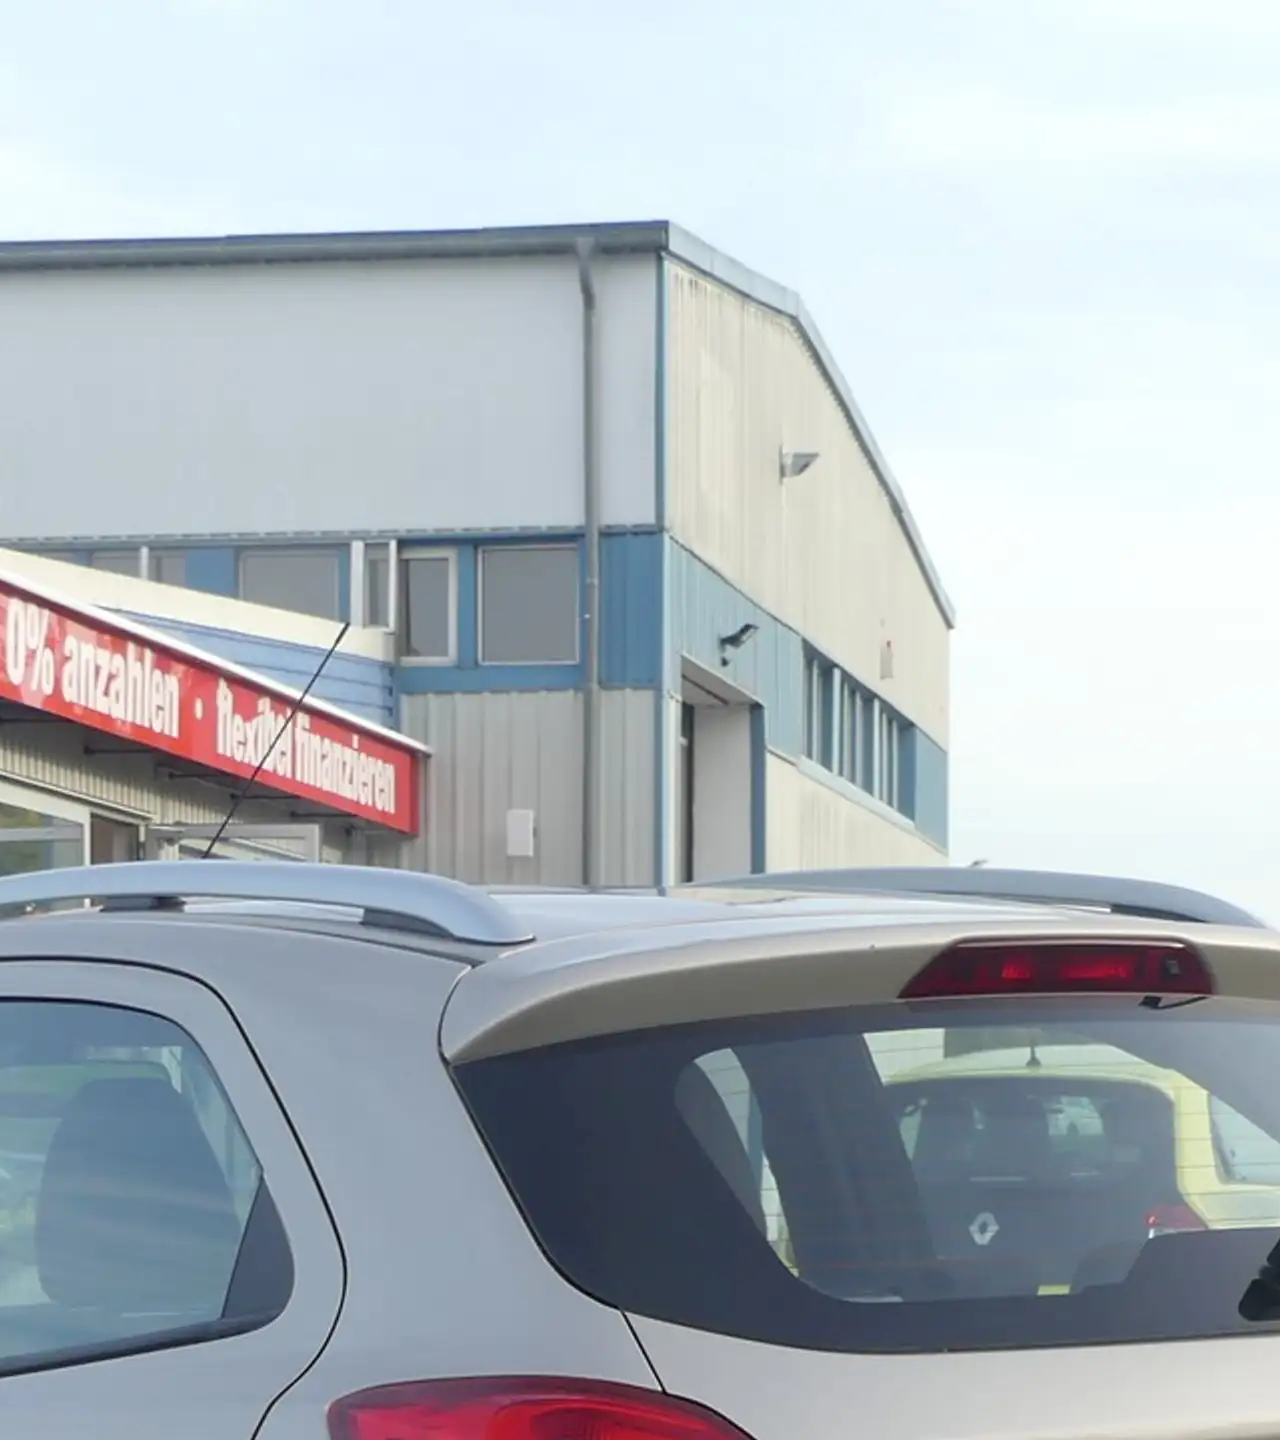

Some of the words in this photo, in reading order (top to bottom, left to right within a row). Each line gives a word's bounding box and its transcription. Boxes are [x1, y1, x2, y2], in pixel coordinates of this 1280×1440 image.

[6, 597, 55, 696] 0%
[61, 635, 180, 738] anzahlen
[216, 677, 293, 779] flexibel
[295, 710, 396, 815] finanzieren
